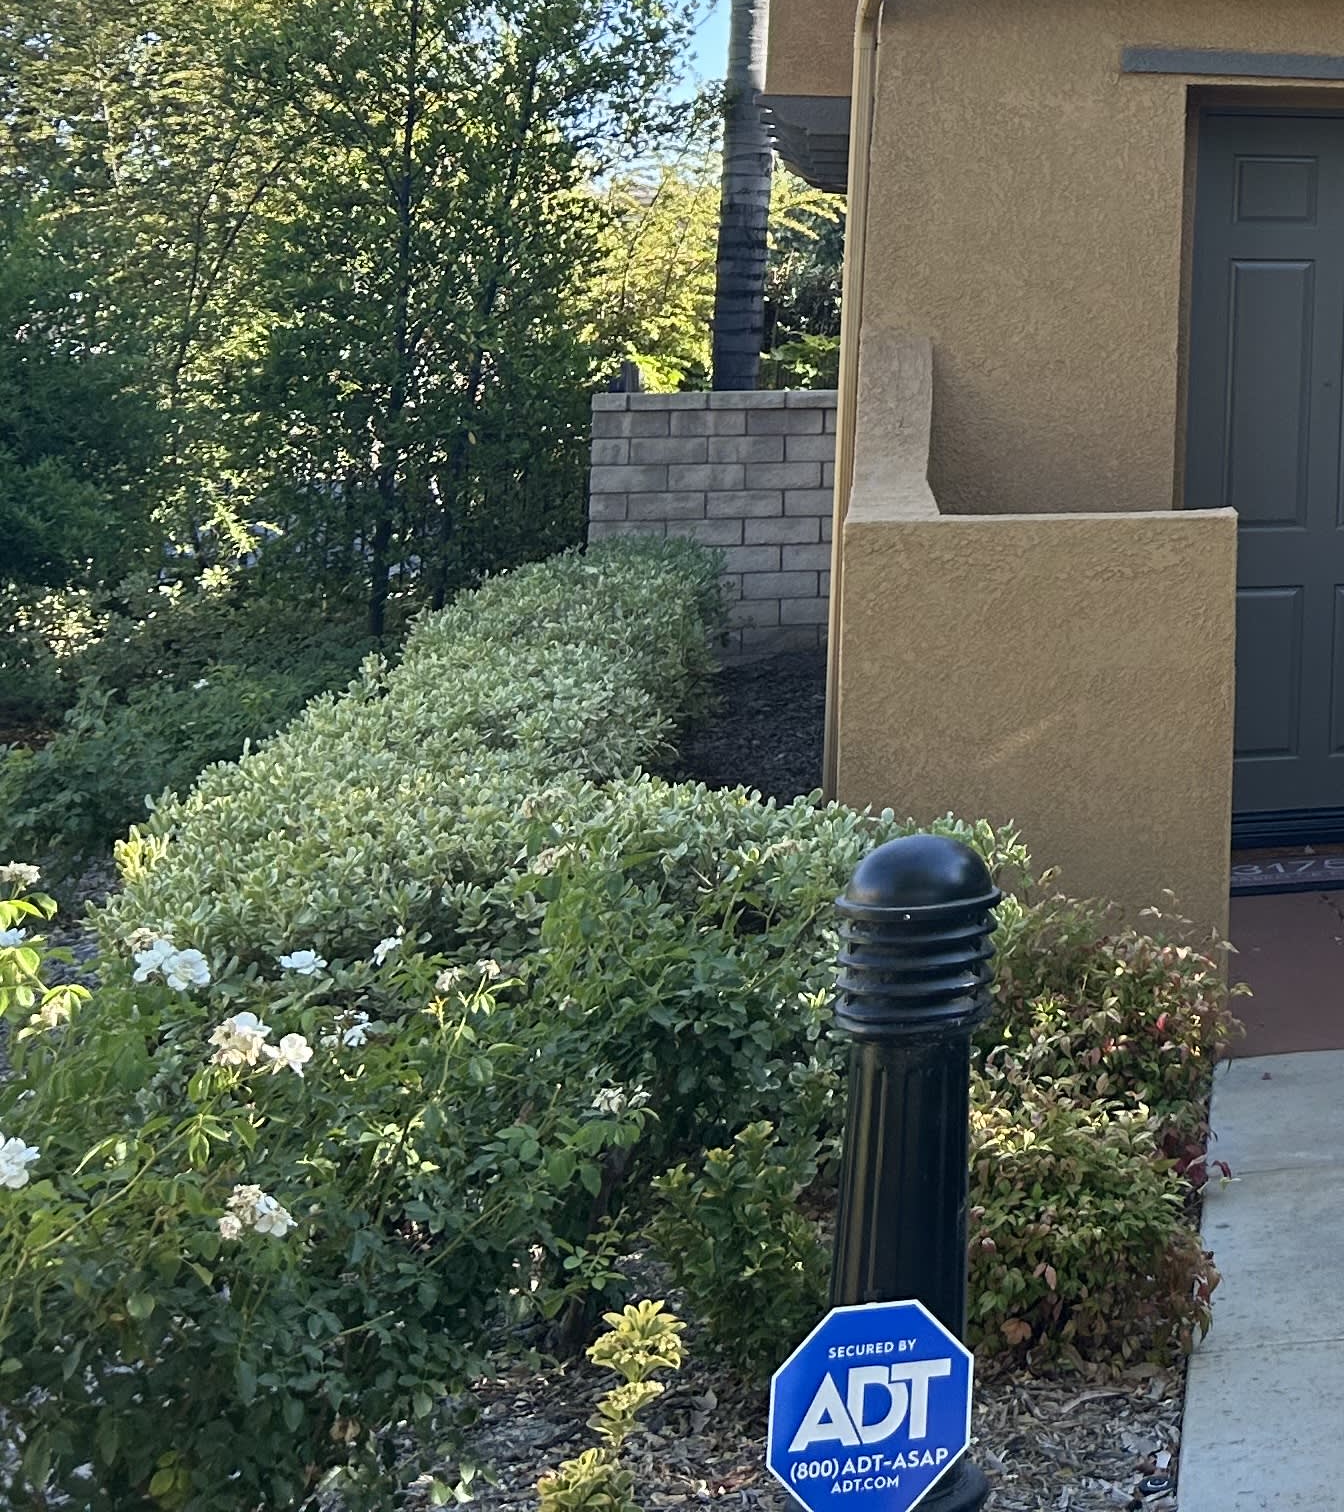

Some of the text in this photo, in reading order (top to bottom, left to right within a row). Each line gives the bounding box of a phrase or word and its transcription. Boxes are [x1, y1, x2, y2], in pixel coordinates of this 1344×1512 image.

[828, 1338, 917, 1359] SECURED BY
[787, 1357, 952, 1453] ADT
[789, 1447, 949, 1484] (800) ADT-ASAP
[830, 1475, 900, 1494] ADT.COM
